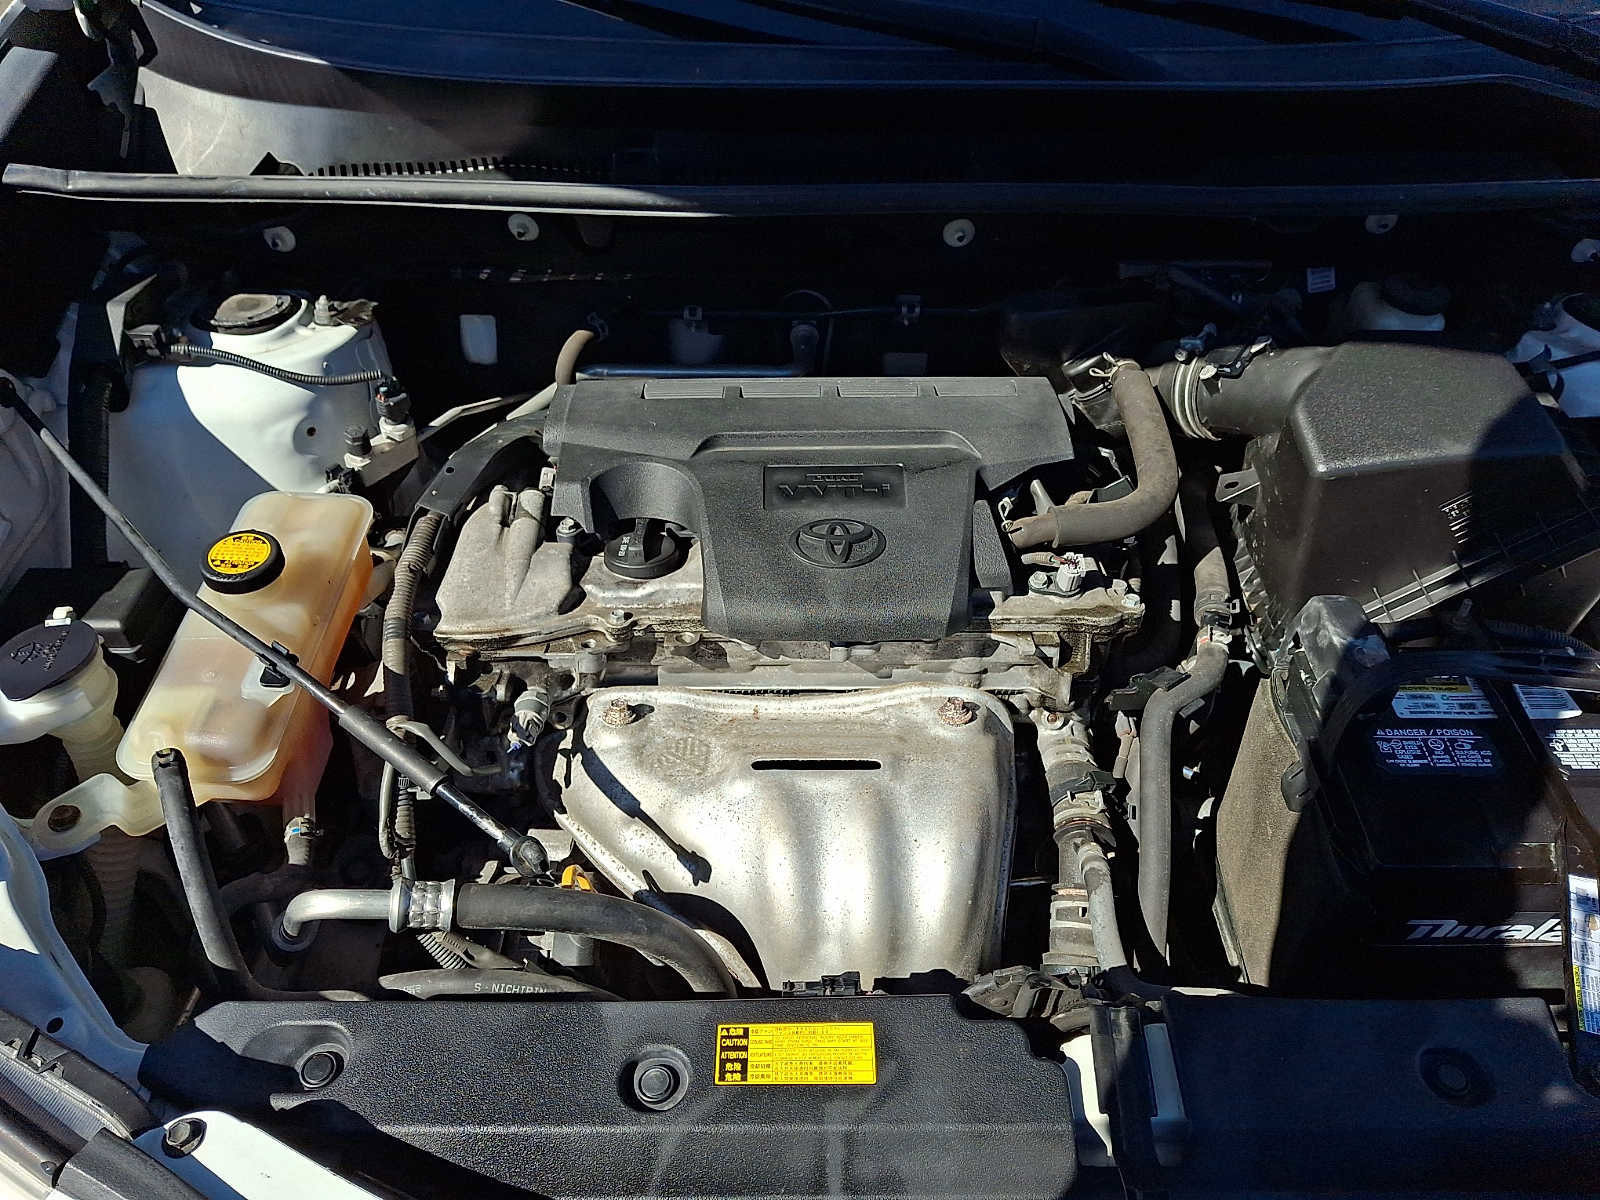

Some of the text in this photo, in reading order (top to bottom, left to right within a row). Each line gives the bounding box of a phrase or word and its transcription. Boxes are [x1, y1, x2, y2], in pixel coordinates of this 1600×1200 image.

[1386, 728, 1426, 736] DANGER
[1436, 728, 1474, 736] POISON
[721, 1038, 748, 1047] CAUTION
[721, 1051, 748, 1060] ATTENTION
